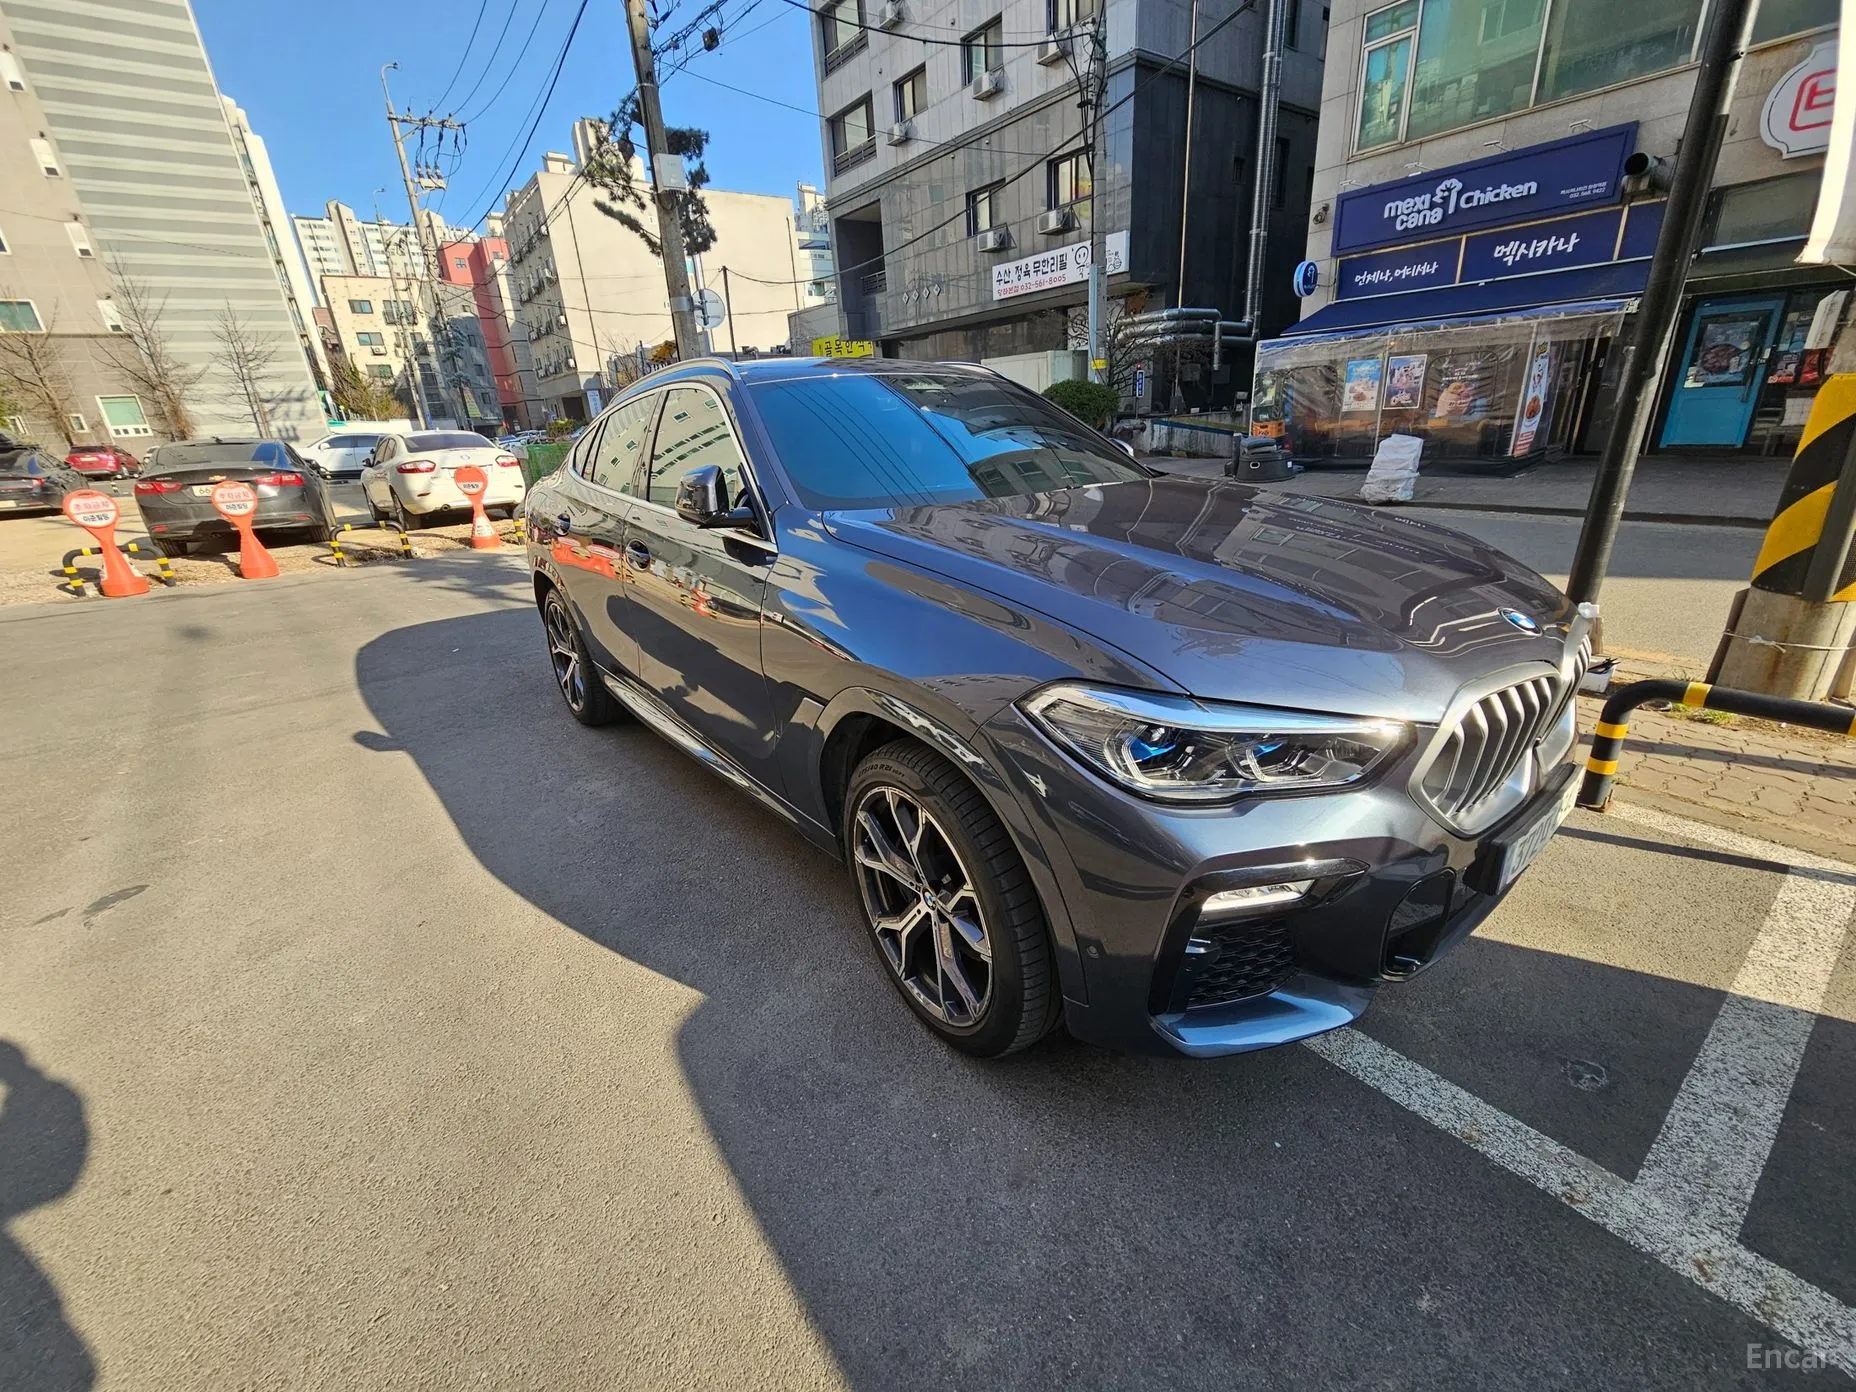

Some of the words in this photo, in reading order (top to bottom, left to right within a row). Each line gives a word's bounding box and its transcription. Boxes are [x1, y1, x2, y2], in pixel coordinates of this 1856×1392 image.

[1384, 193, 1431, 218] mexi
[1460, 181, 1538, 208] Chicken
[1395, 207, 1443, 230] cana
[1493, 232, 1580, 266] 멕시카나
[1015, 263, 1031, 281] 정육
[1033, 252, 1067, 277] 무한리필
